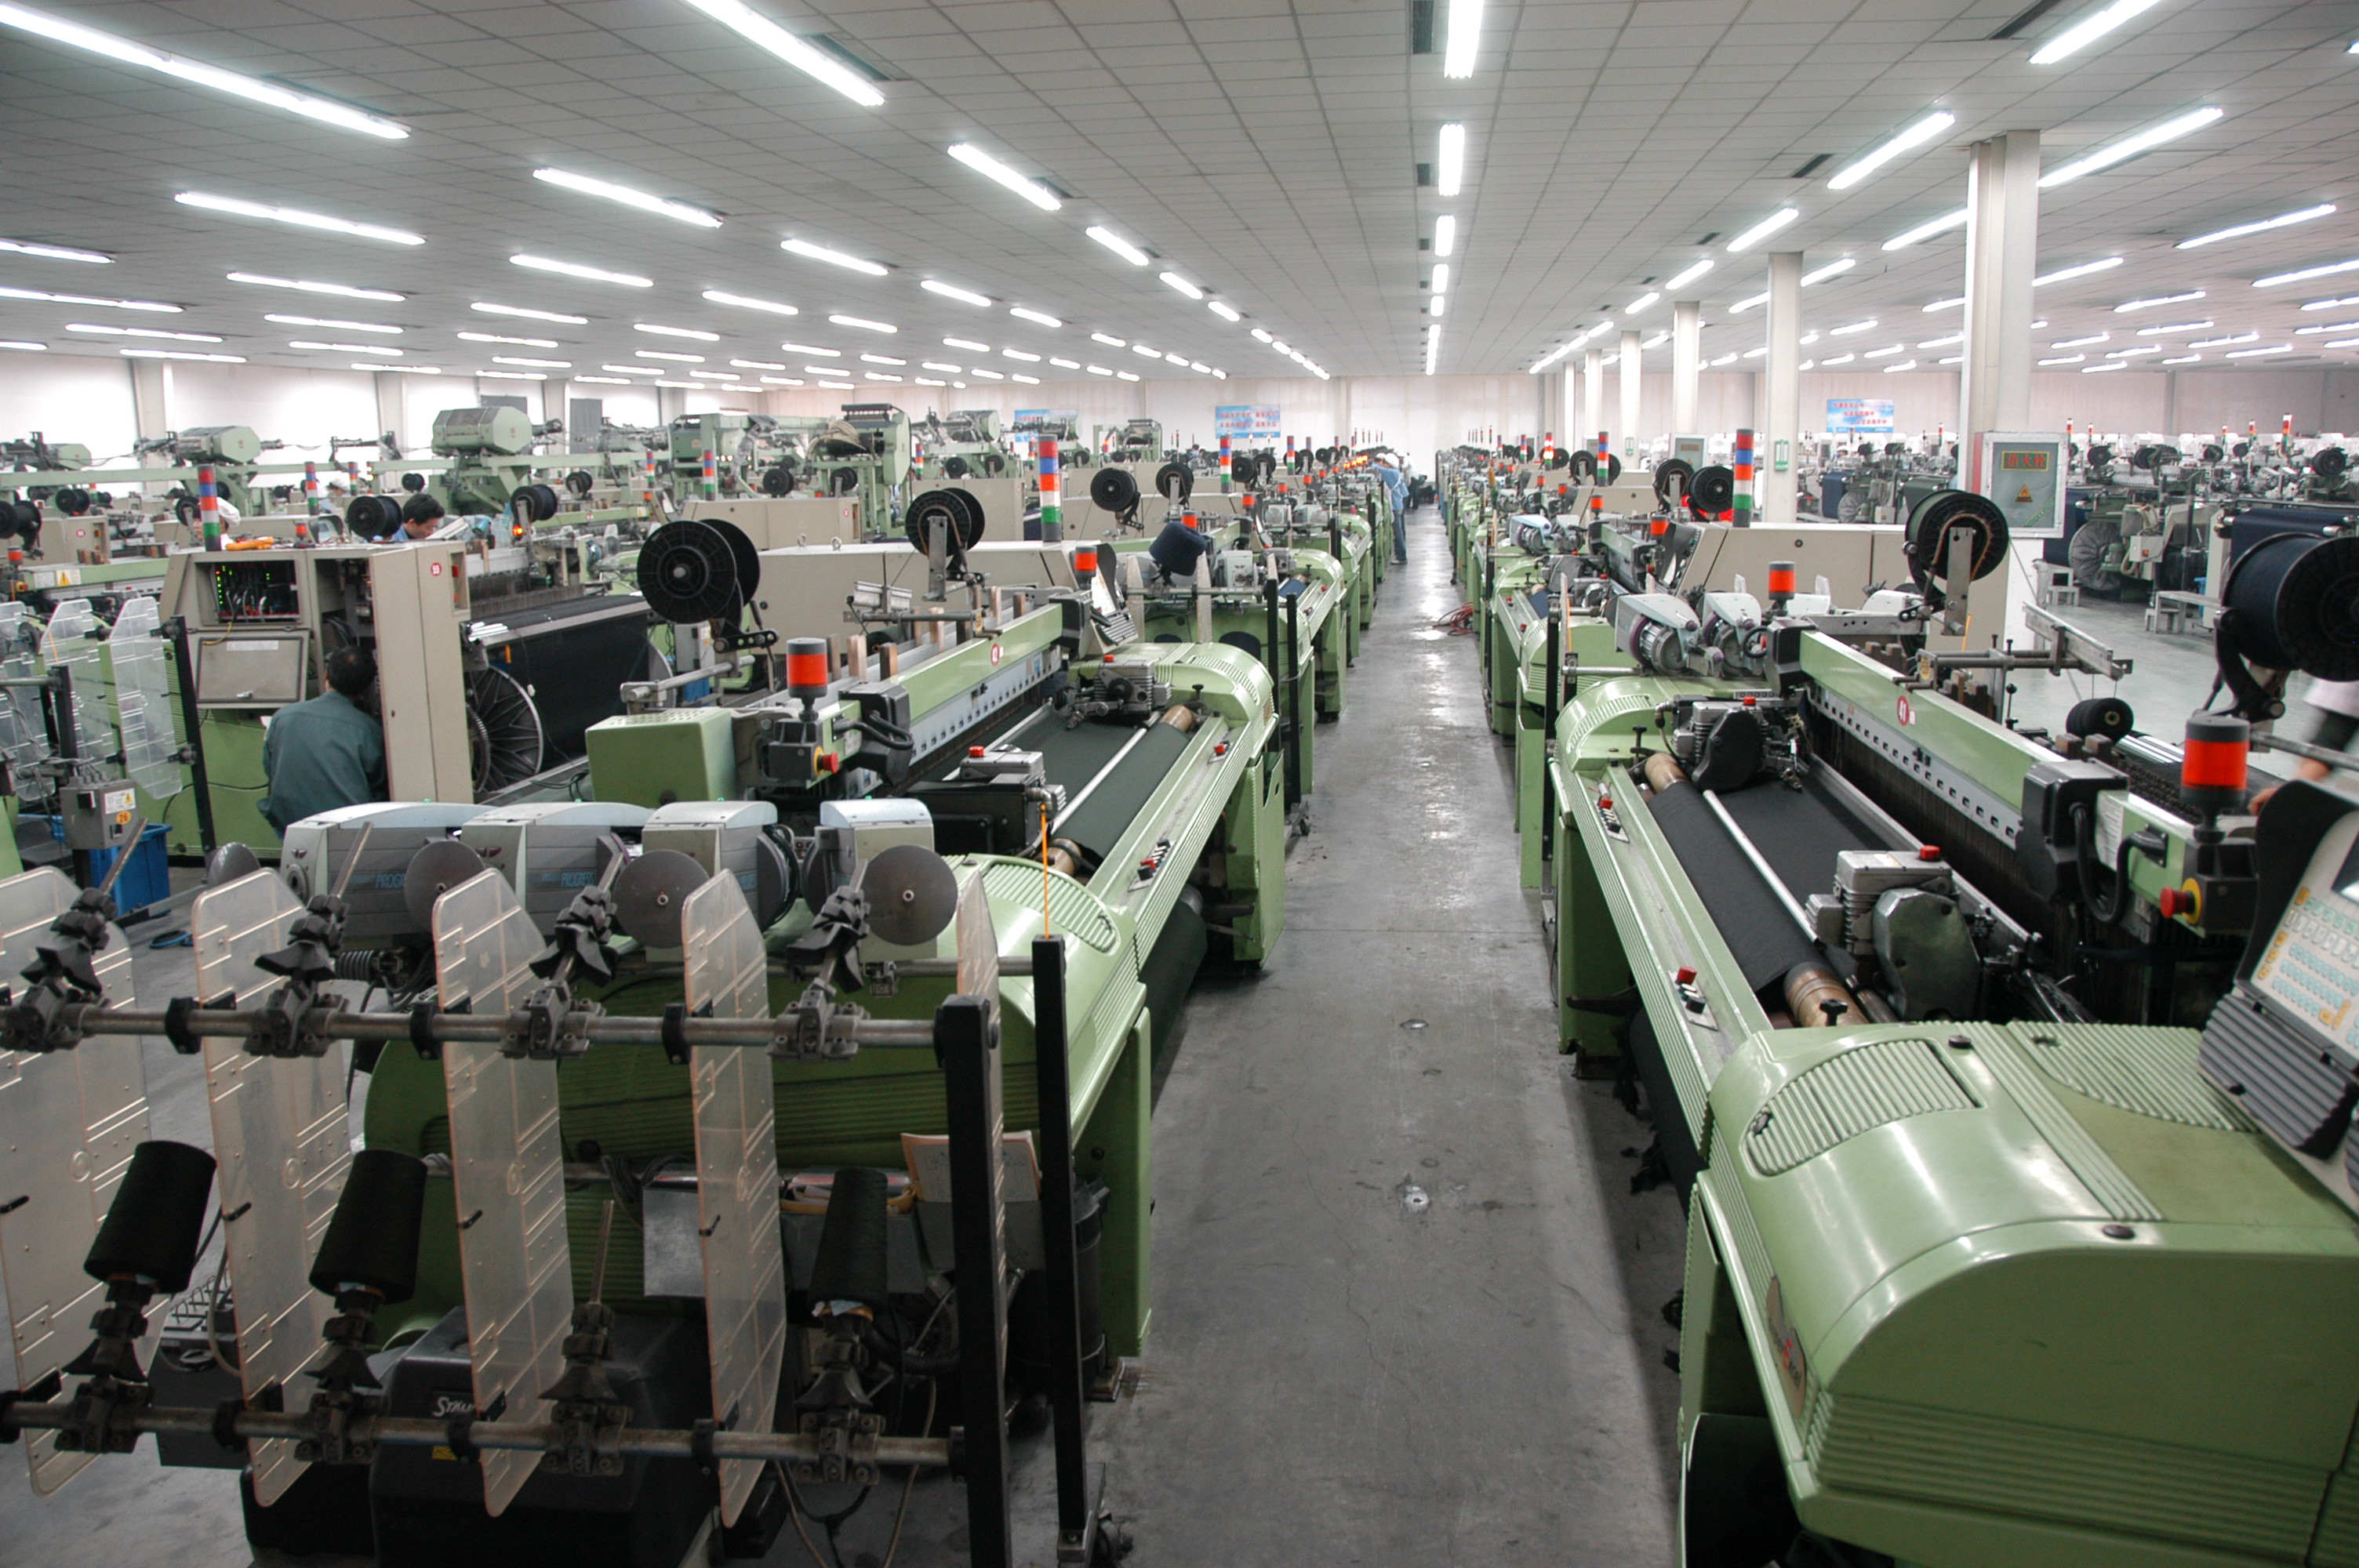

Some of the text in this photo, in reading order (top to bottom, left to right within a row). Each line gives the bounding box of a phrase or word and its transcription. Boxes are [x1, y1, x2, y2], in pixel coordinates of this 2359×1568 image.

[2007, 452, 2046, 468] 消火栓
[119, 812, 129, 823] 26
